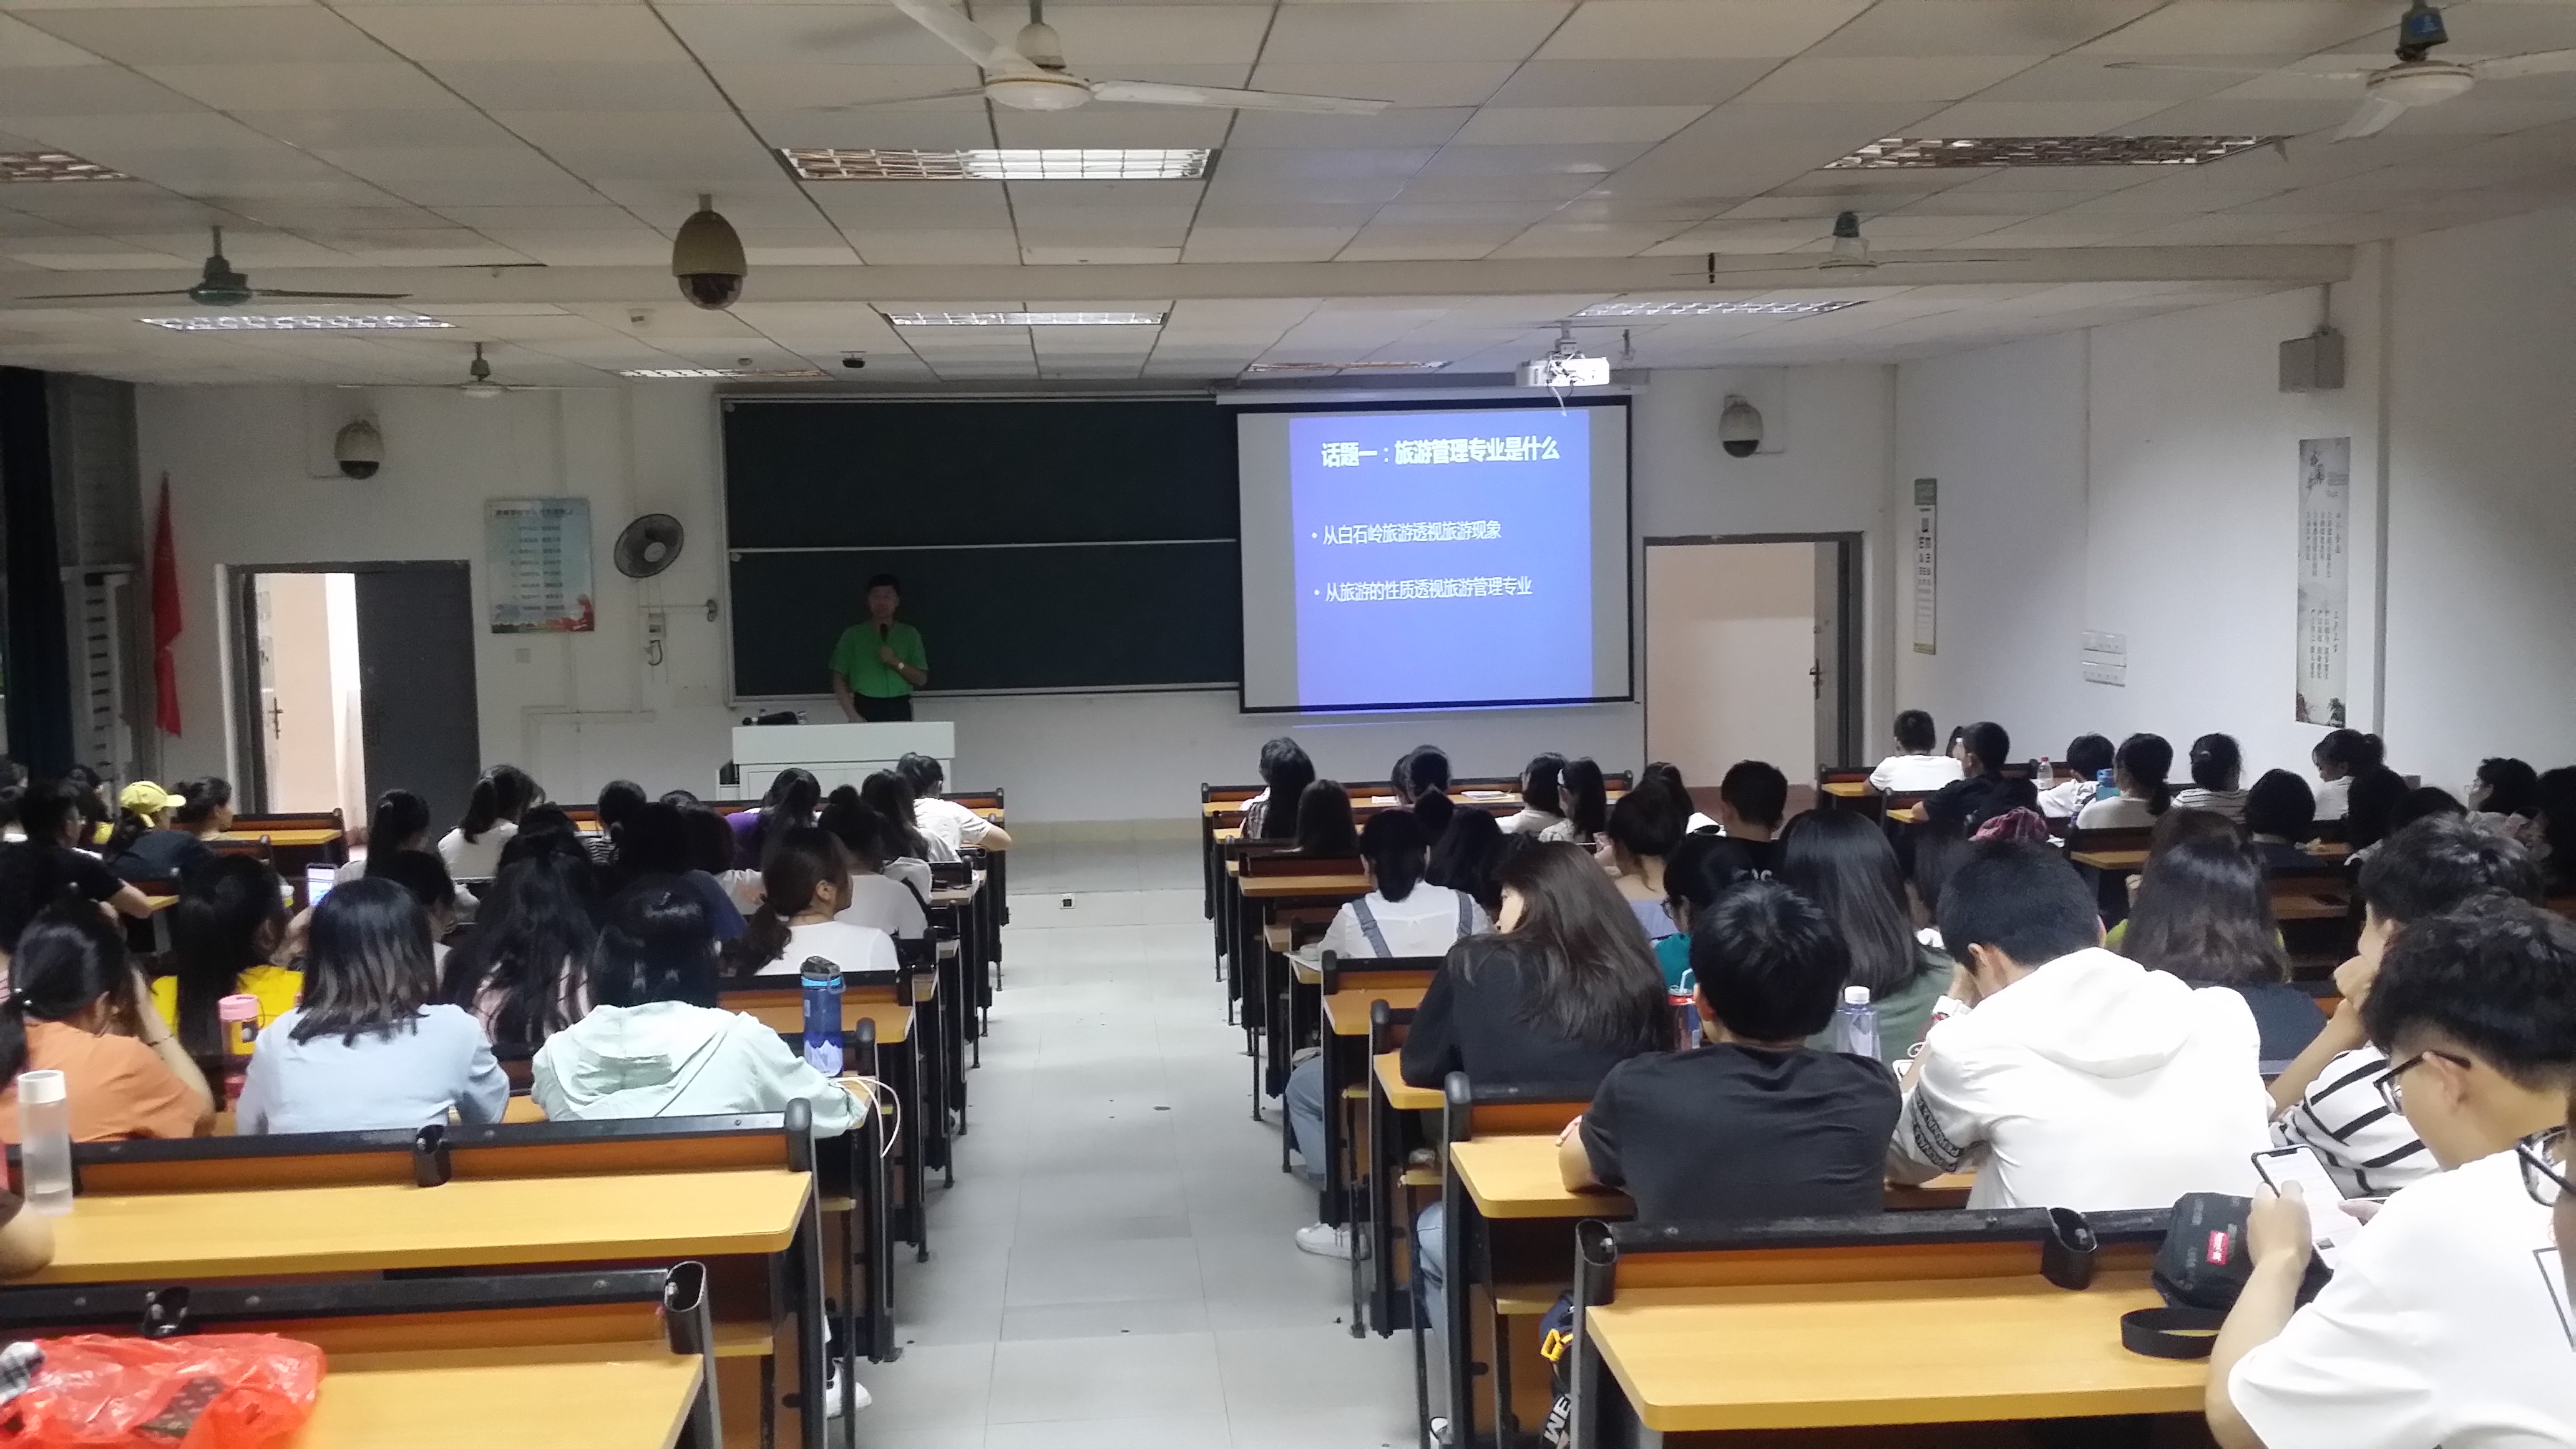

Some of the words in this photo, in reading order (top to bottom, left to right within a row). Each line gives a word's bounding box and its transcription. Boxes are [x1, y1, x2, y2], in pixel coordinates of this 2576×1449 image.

[1321, 436, 1560, 467] 话题一：旅游管理专业是什么
[1322, 520, 1501, 545] 从白石岭旅游透视旅游现象
[1325, 576, 1533, 602] 从旅游的性质透视旅游管理专业
